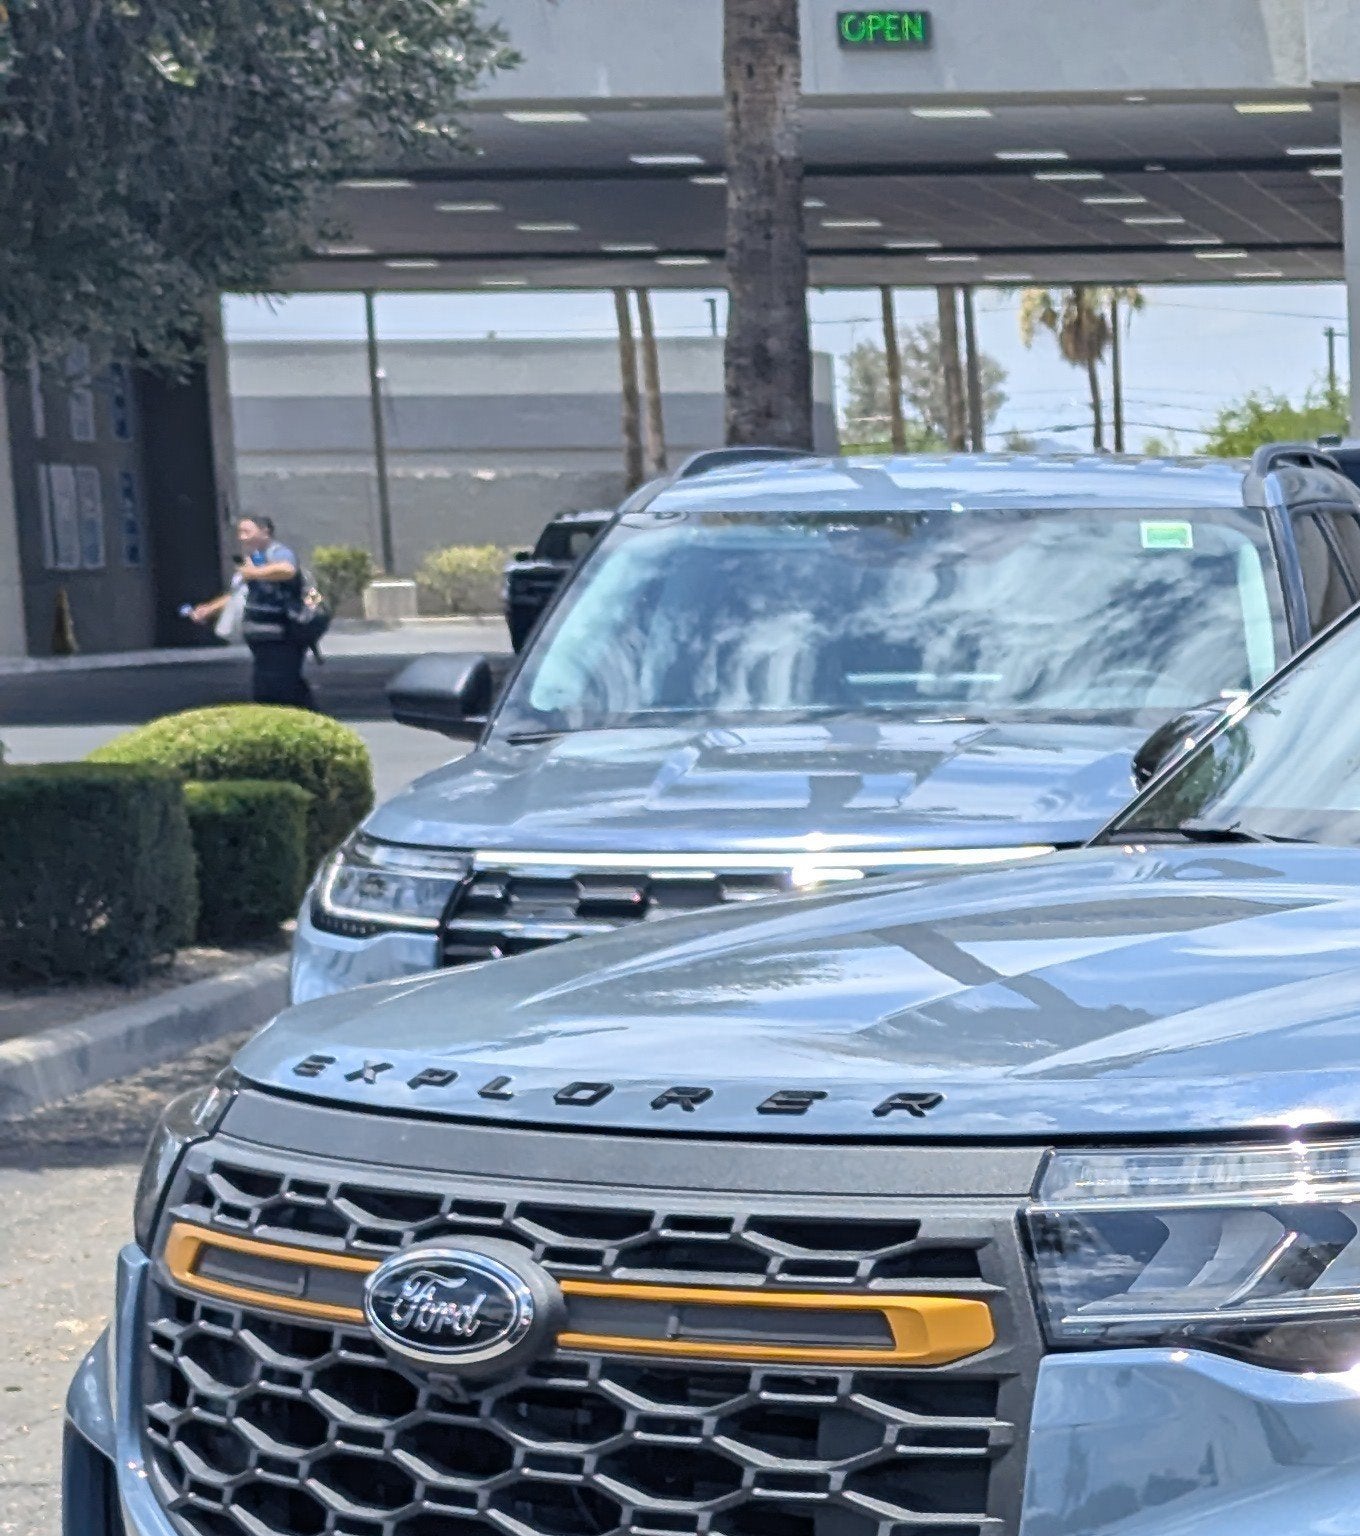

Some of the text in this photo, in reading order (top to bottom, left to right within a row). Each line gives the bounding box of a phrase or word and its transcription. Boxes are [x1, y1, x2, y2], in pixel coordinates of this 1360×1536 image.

[841, 13, 924, 42] OPEN
[292, 1054, 947, 1118] EXPLORER
[390, 1269, 488, 1338] Ford
